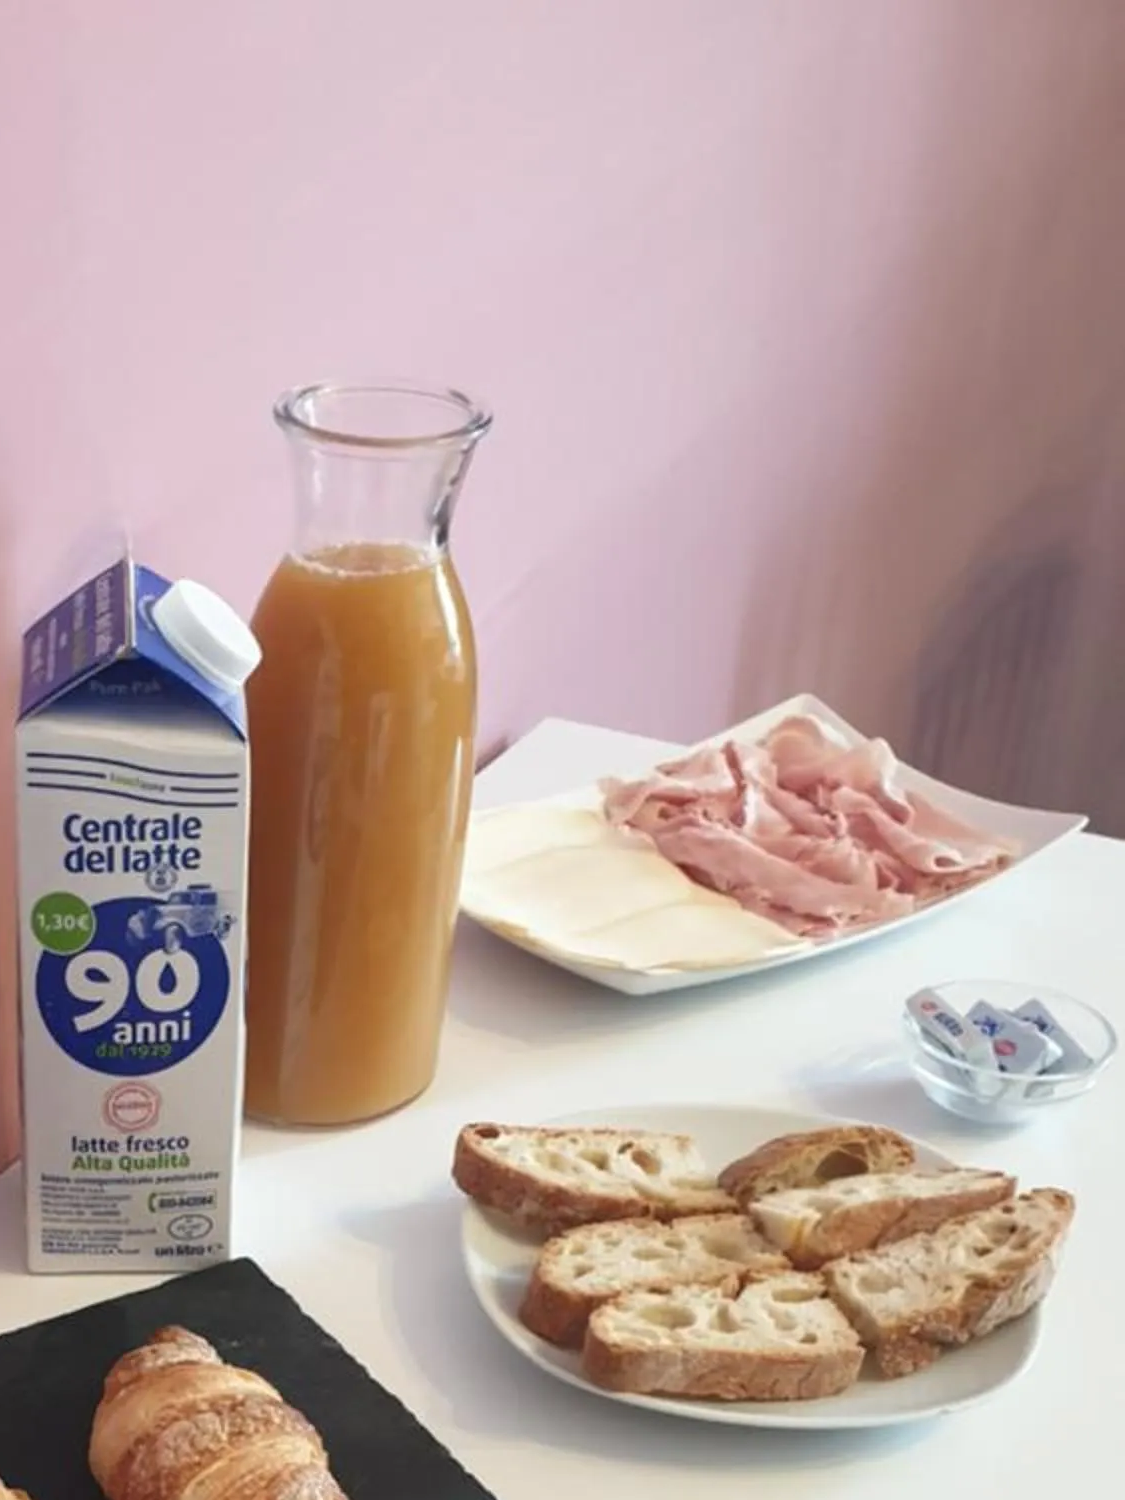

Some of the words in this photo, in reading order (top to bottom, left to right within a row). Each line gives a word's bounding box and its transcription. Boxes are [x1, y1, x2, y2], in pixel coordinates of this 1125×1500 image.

[63, 813, 202, 843] Centrale
[63, 845, 115, 873] del
[122, 844, 201, 872] latte
[36, 914, 90, 932] 1,30€
[65, 948, 200, 1033] 90
[113, 1011, 191, 1044] anni
[95, 1042, 123, 1057] dal
[71, 1136, 119, 1153] latte
[126, 1135, 189, 1152] fresco
[71, 1155, 113, 1171] Alta
[119, 1152, 190, 1173] Qualità
